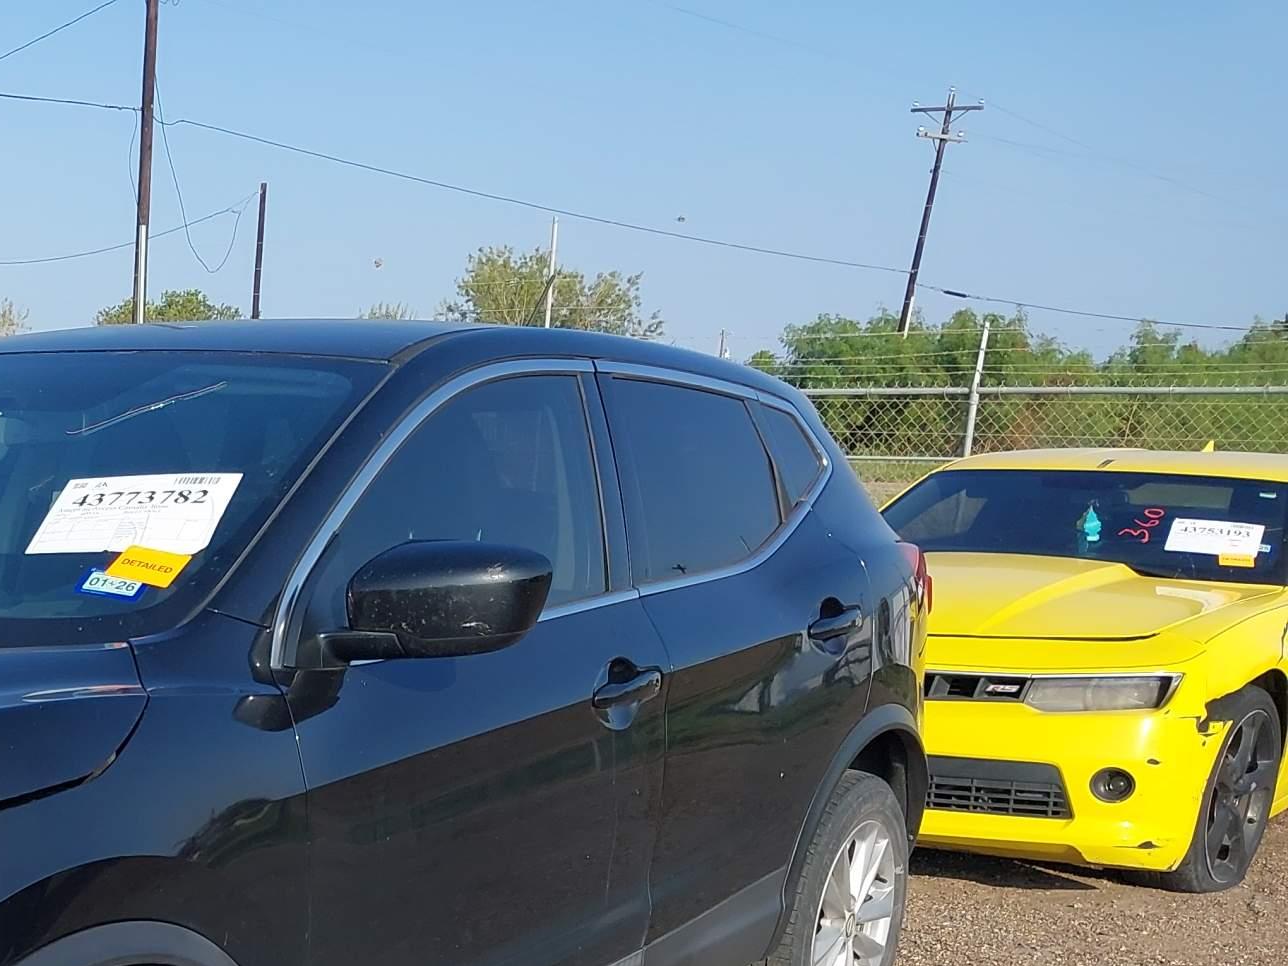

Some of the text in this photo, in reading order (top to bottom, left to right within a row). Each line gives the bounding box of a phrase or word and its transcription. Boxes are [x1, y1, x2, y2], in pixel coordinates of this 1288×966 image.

[71, 489, 209, 507] 43773782
[1118, 508, 1166, 543] 360
[1180, 525, 1251, 538] 43753193
[121, 557, 173, 575] DETAILED
[984, 685, 1020, 693] RS
